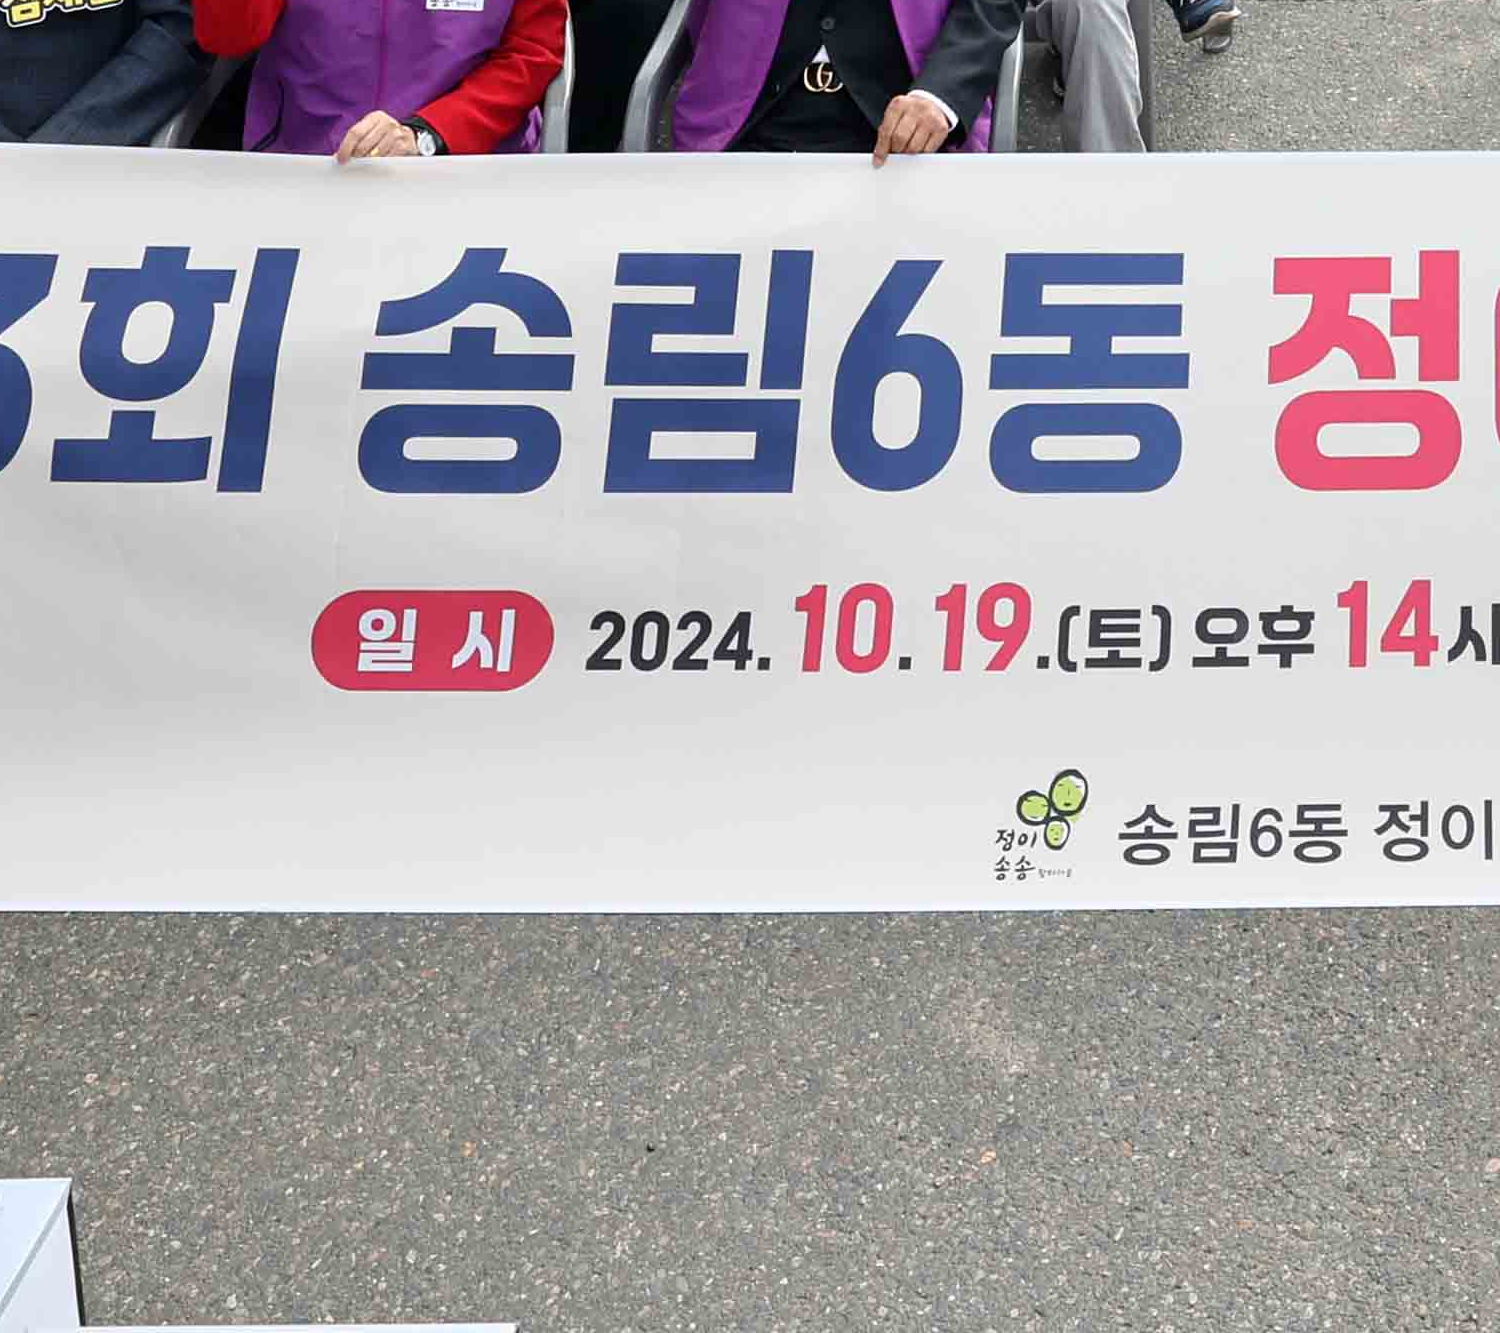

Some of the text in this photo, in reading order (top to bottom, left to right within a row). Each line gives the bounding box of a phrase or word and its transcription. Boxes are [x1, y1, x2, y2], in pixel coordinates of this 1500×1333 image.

[358, 248, 1189, 493] 송림6동
[586, 610, 771, 672] 2024.
[795, 583, 911, 674] 10.
[1192, 605, 1315, 668] 오후
[995, 829, 1037, 852] 정이
[1118, 803, 1348, 866] 송림6동
[994, 855, 1036, 881] 송송
